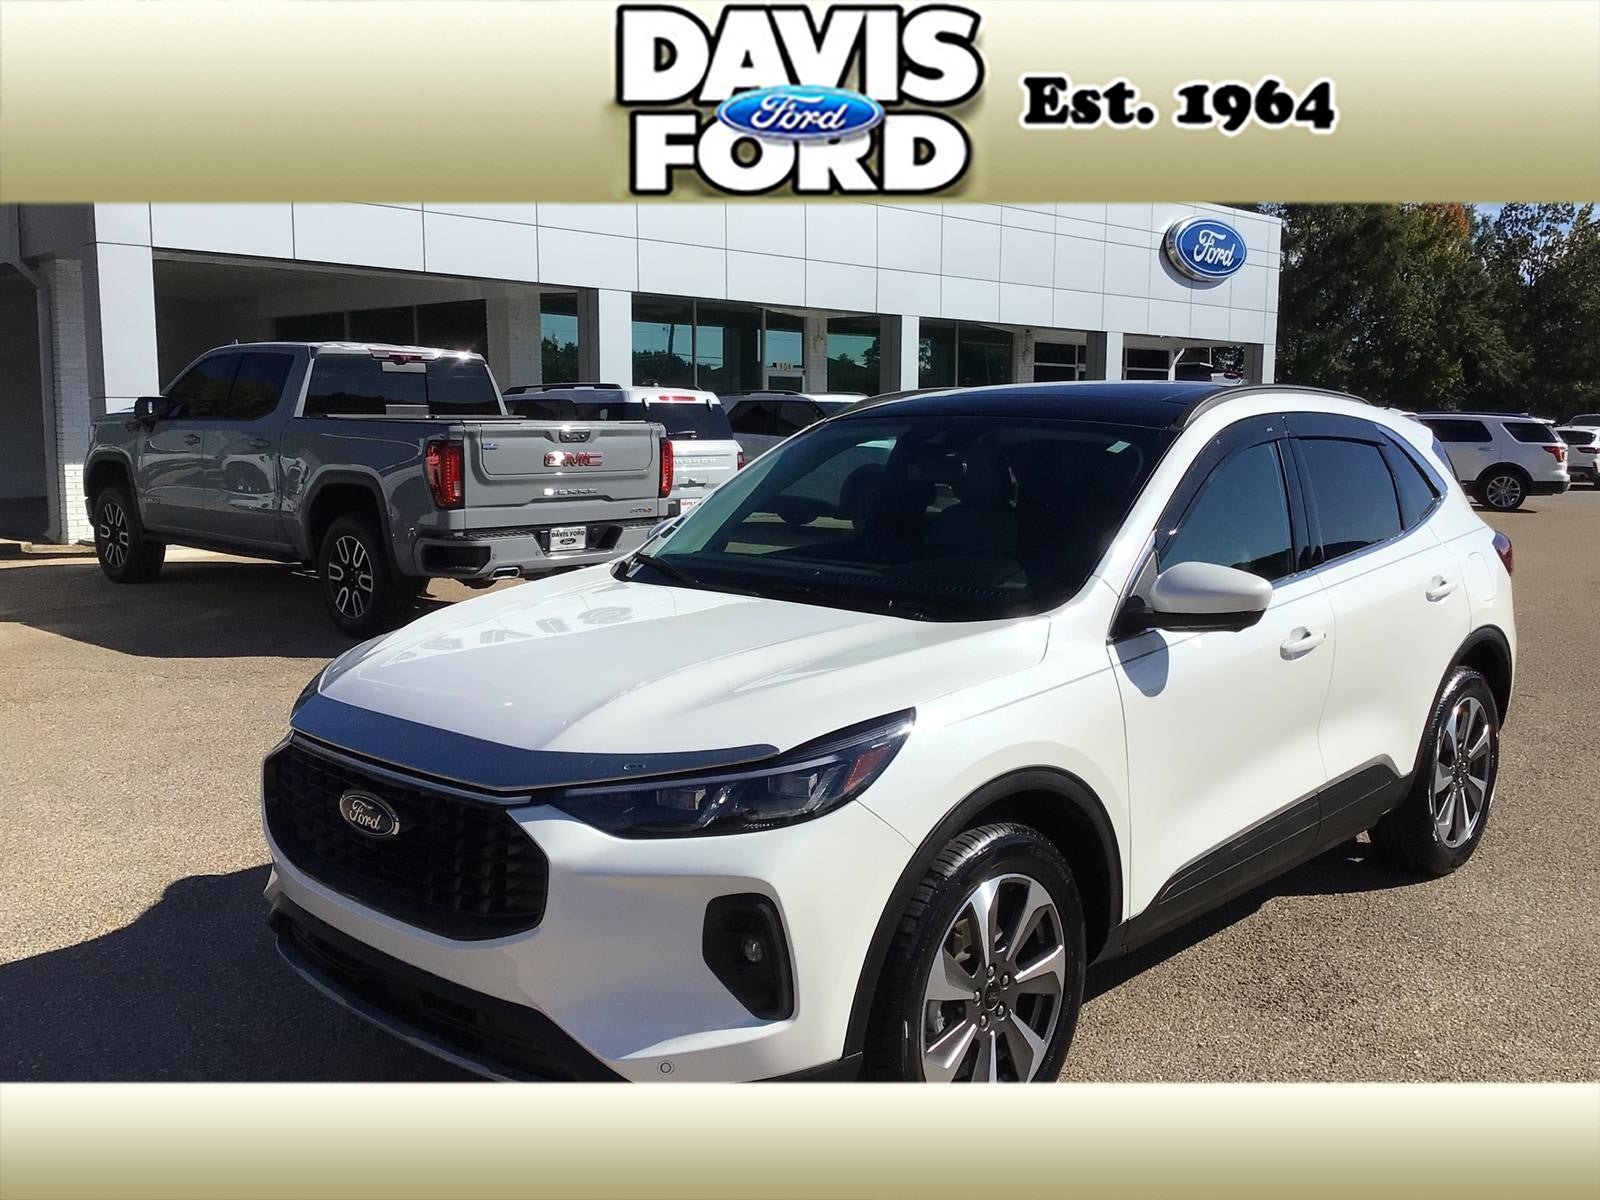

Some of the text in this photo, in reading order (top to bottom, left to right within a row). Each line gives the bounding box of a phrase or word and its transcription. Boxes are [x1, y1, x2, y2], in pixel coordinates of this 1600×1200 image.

[1193, 229, 1236, 267] Ford
[543, 450, 603, 467] GMC
[349, 799, 382, 830] Ford
